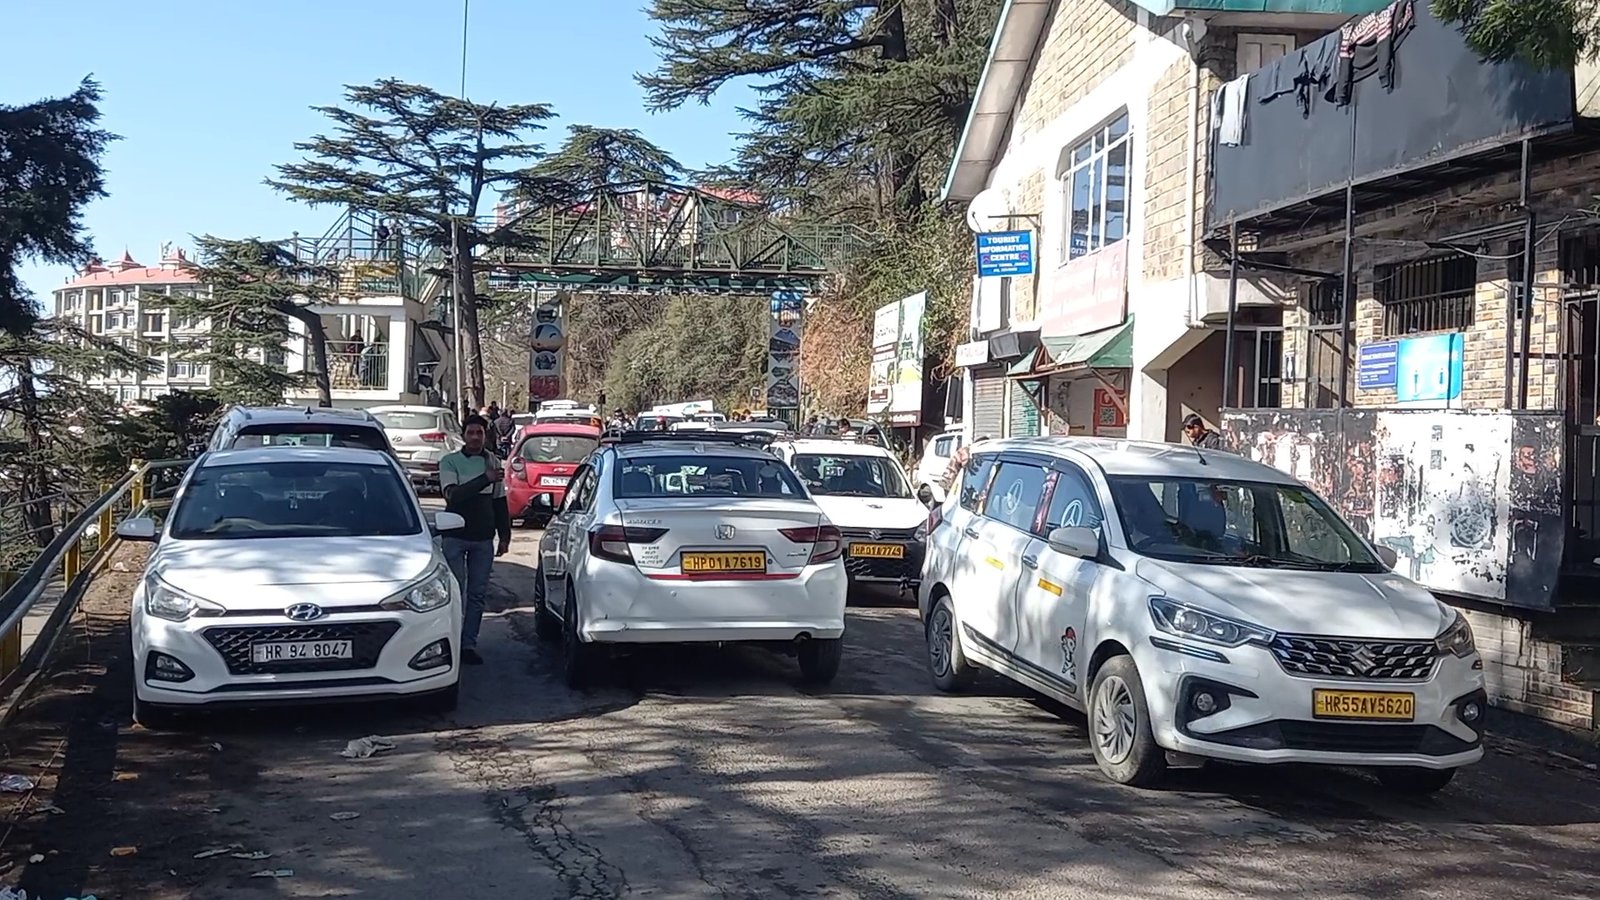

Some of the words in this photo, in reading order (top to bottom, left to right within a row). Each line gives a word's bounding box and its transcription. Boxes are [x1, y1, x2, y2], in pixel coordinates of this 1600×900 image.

[987, 235, 1020, 244] TOURIST
[980, 244, 1029, 253] INFORMATION
[990, 253, 1020, 262] CENTRE
[693, 556, 761, 569] HP01A7619
[264, 645, 282, 659] HR
[289, 644, 306, 657] 94
[313, 642, 348, 656] 8047
[1325, 695, 1411, 714] HR55AV5620
